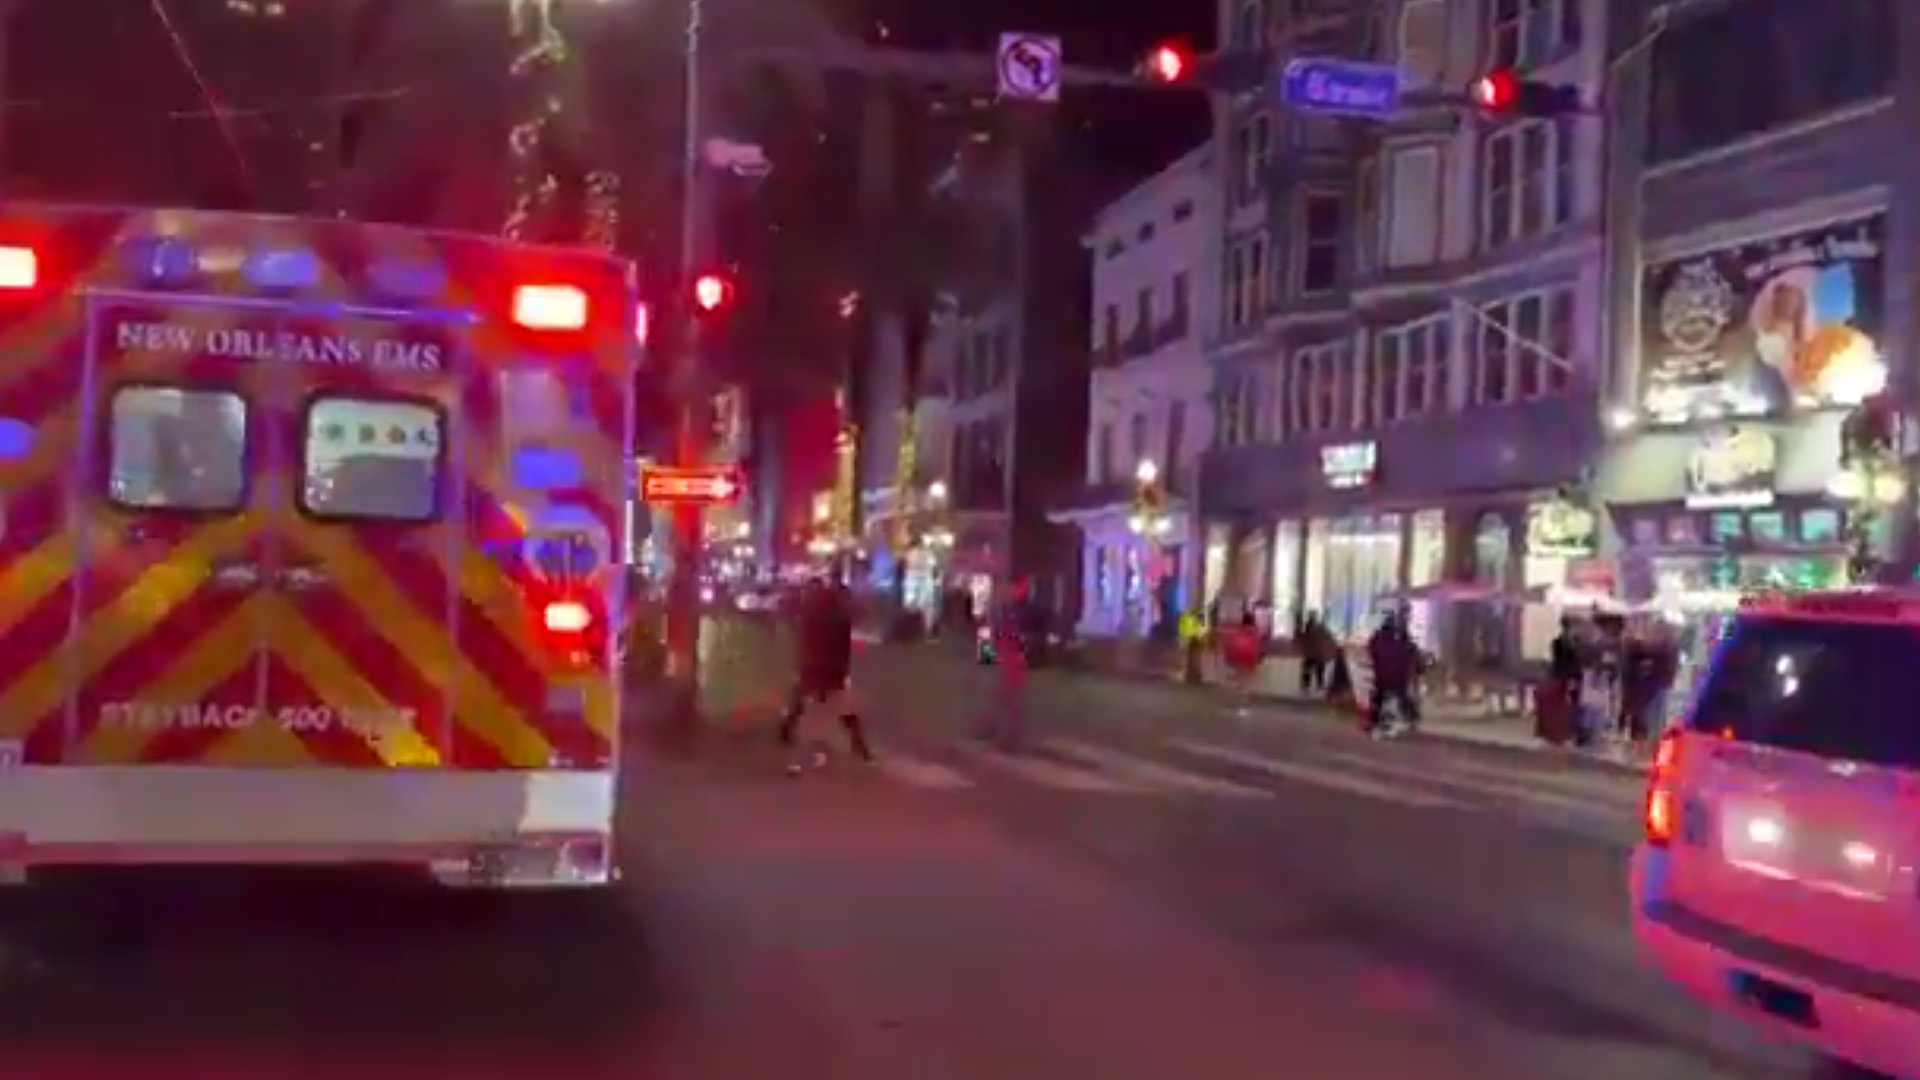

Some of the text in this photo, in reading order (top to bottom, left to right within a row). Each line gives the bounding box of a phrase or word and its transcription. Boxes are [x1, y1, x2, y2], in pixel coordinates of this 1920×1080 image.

[117, 321, 194, 351] NEW
[373, 338, 441, 371] EMS
[278, 704, 331, 731] 500
